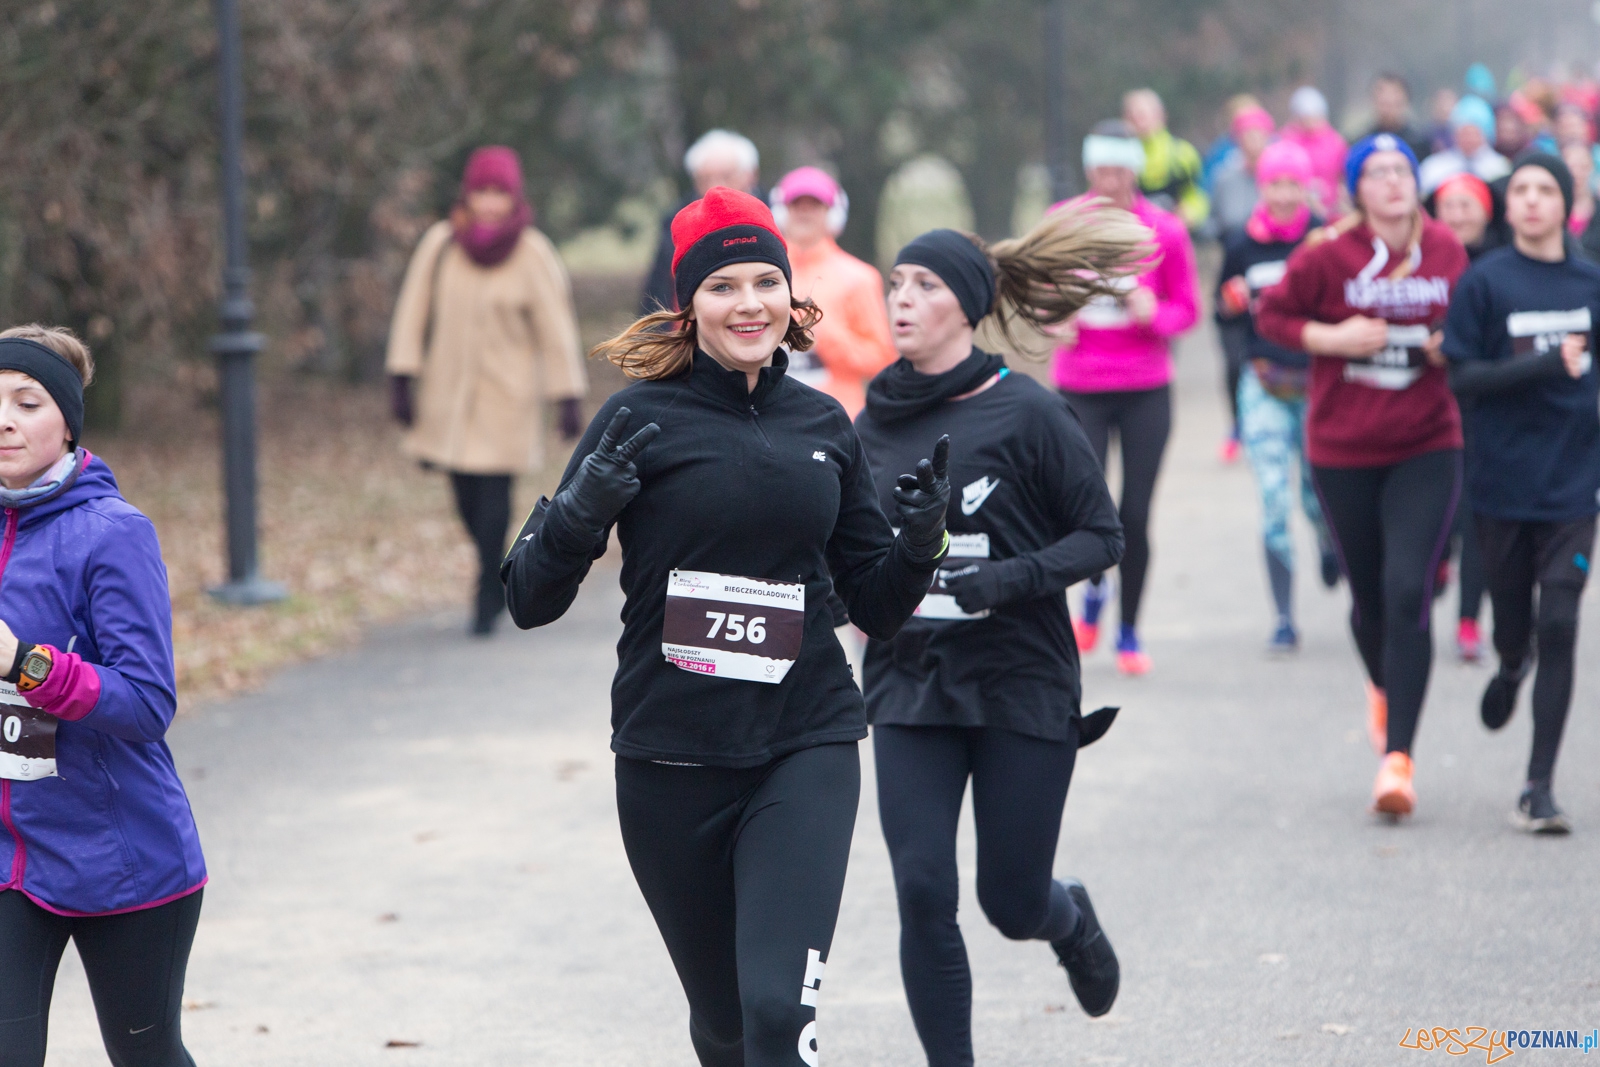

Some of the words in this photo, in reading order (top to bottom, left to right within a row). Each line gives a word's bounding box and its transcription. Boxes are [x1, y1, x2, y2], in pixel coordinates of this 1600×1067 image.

[724, 585, 799, 601] BIEGCZEKOLADOWY.PL
[705, 611, 767, 644] 756
[0, 714, 21, 743] 0
